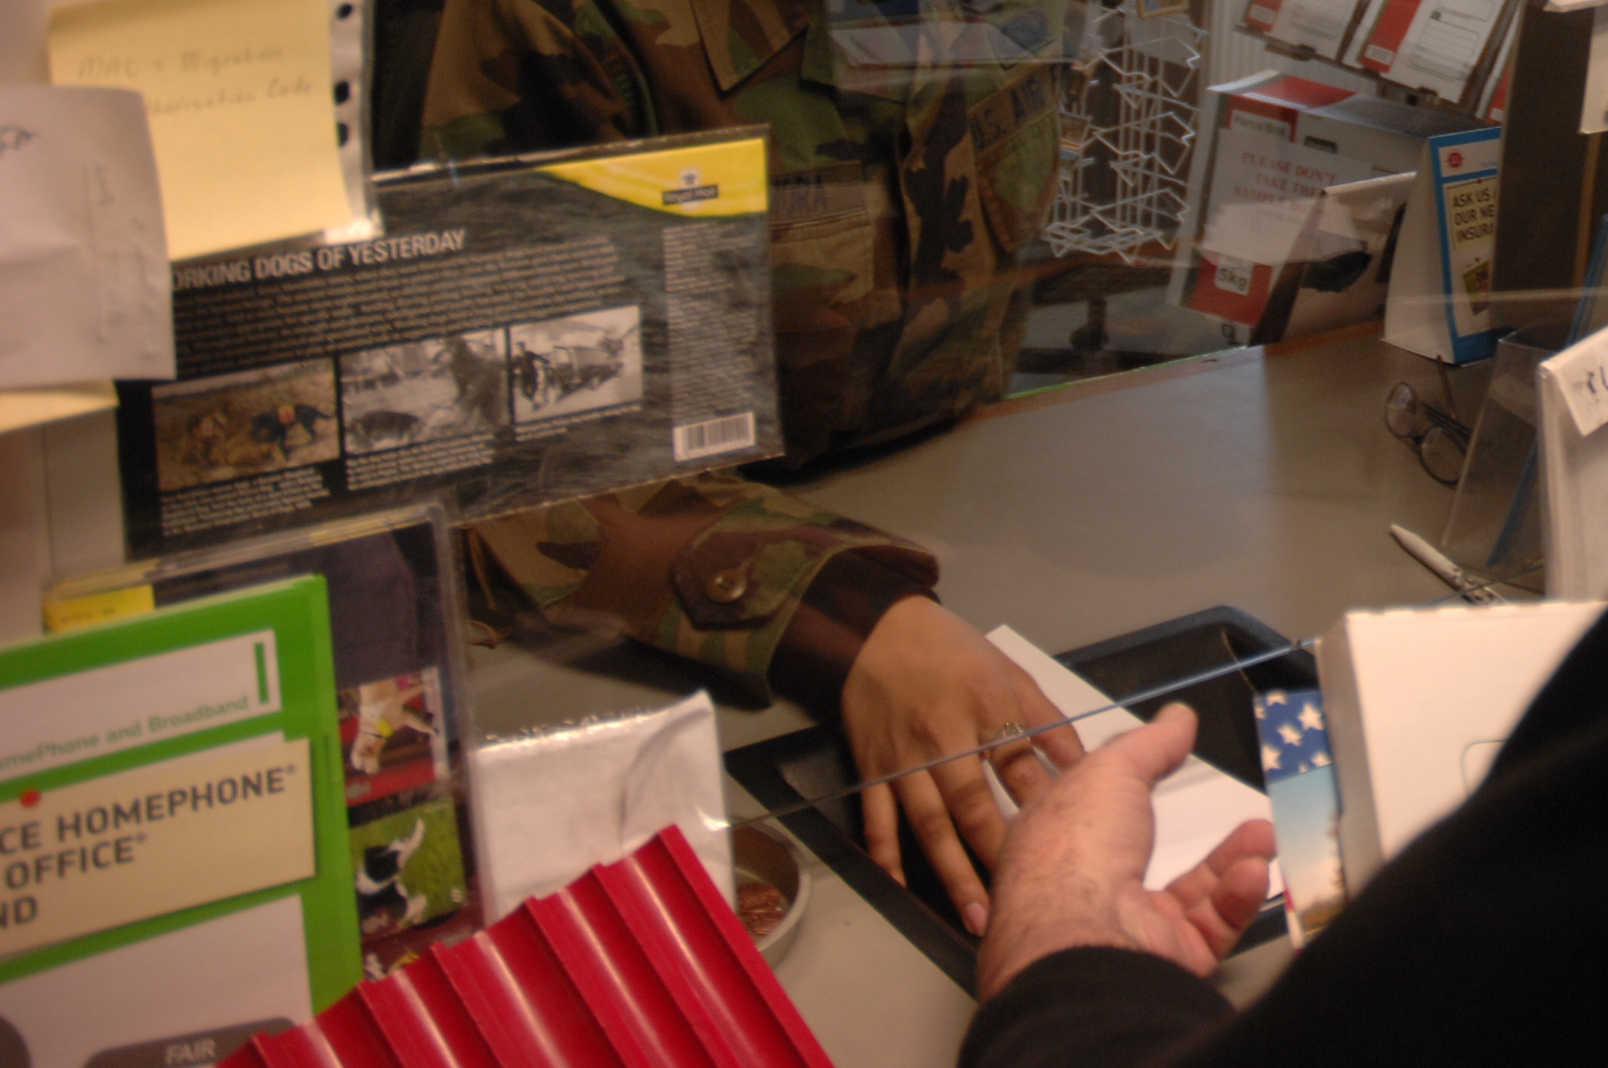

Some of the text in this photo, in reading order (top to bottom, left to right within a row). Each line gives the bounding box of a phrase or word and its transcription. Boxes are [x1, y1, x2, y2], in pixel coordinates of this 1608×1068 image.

[79, 55, 140, 79] MAC
[1242, 152, 1338, 182] PLEASE DON'T
[1255, 172, 1323, 197] TAKE THE
[1453, 188, 1491, 208] ASK US
[1454, 204, 1496, 225] OUR NE
[174, 229, 465, 289] ORKING DOGS OF YESTERDAY
[106, 720, 142, 744] and
[147, 695, 248, 735] Broadband
[165, 1038, 216, 1065] FAIR
